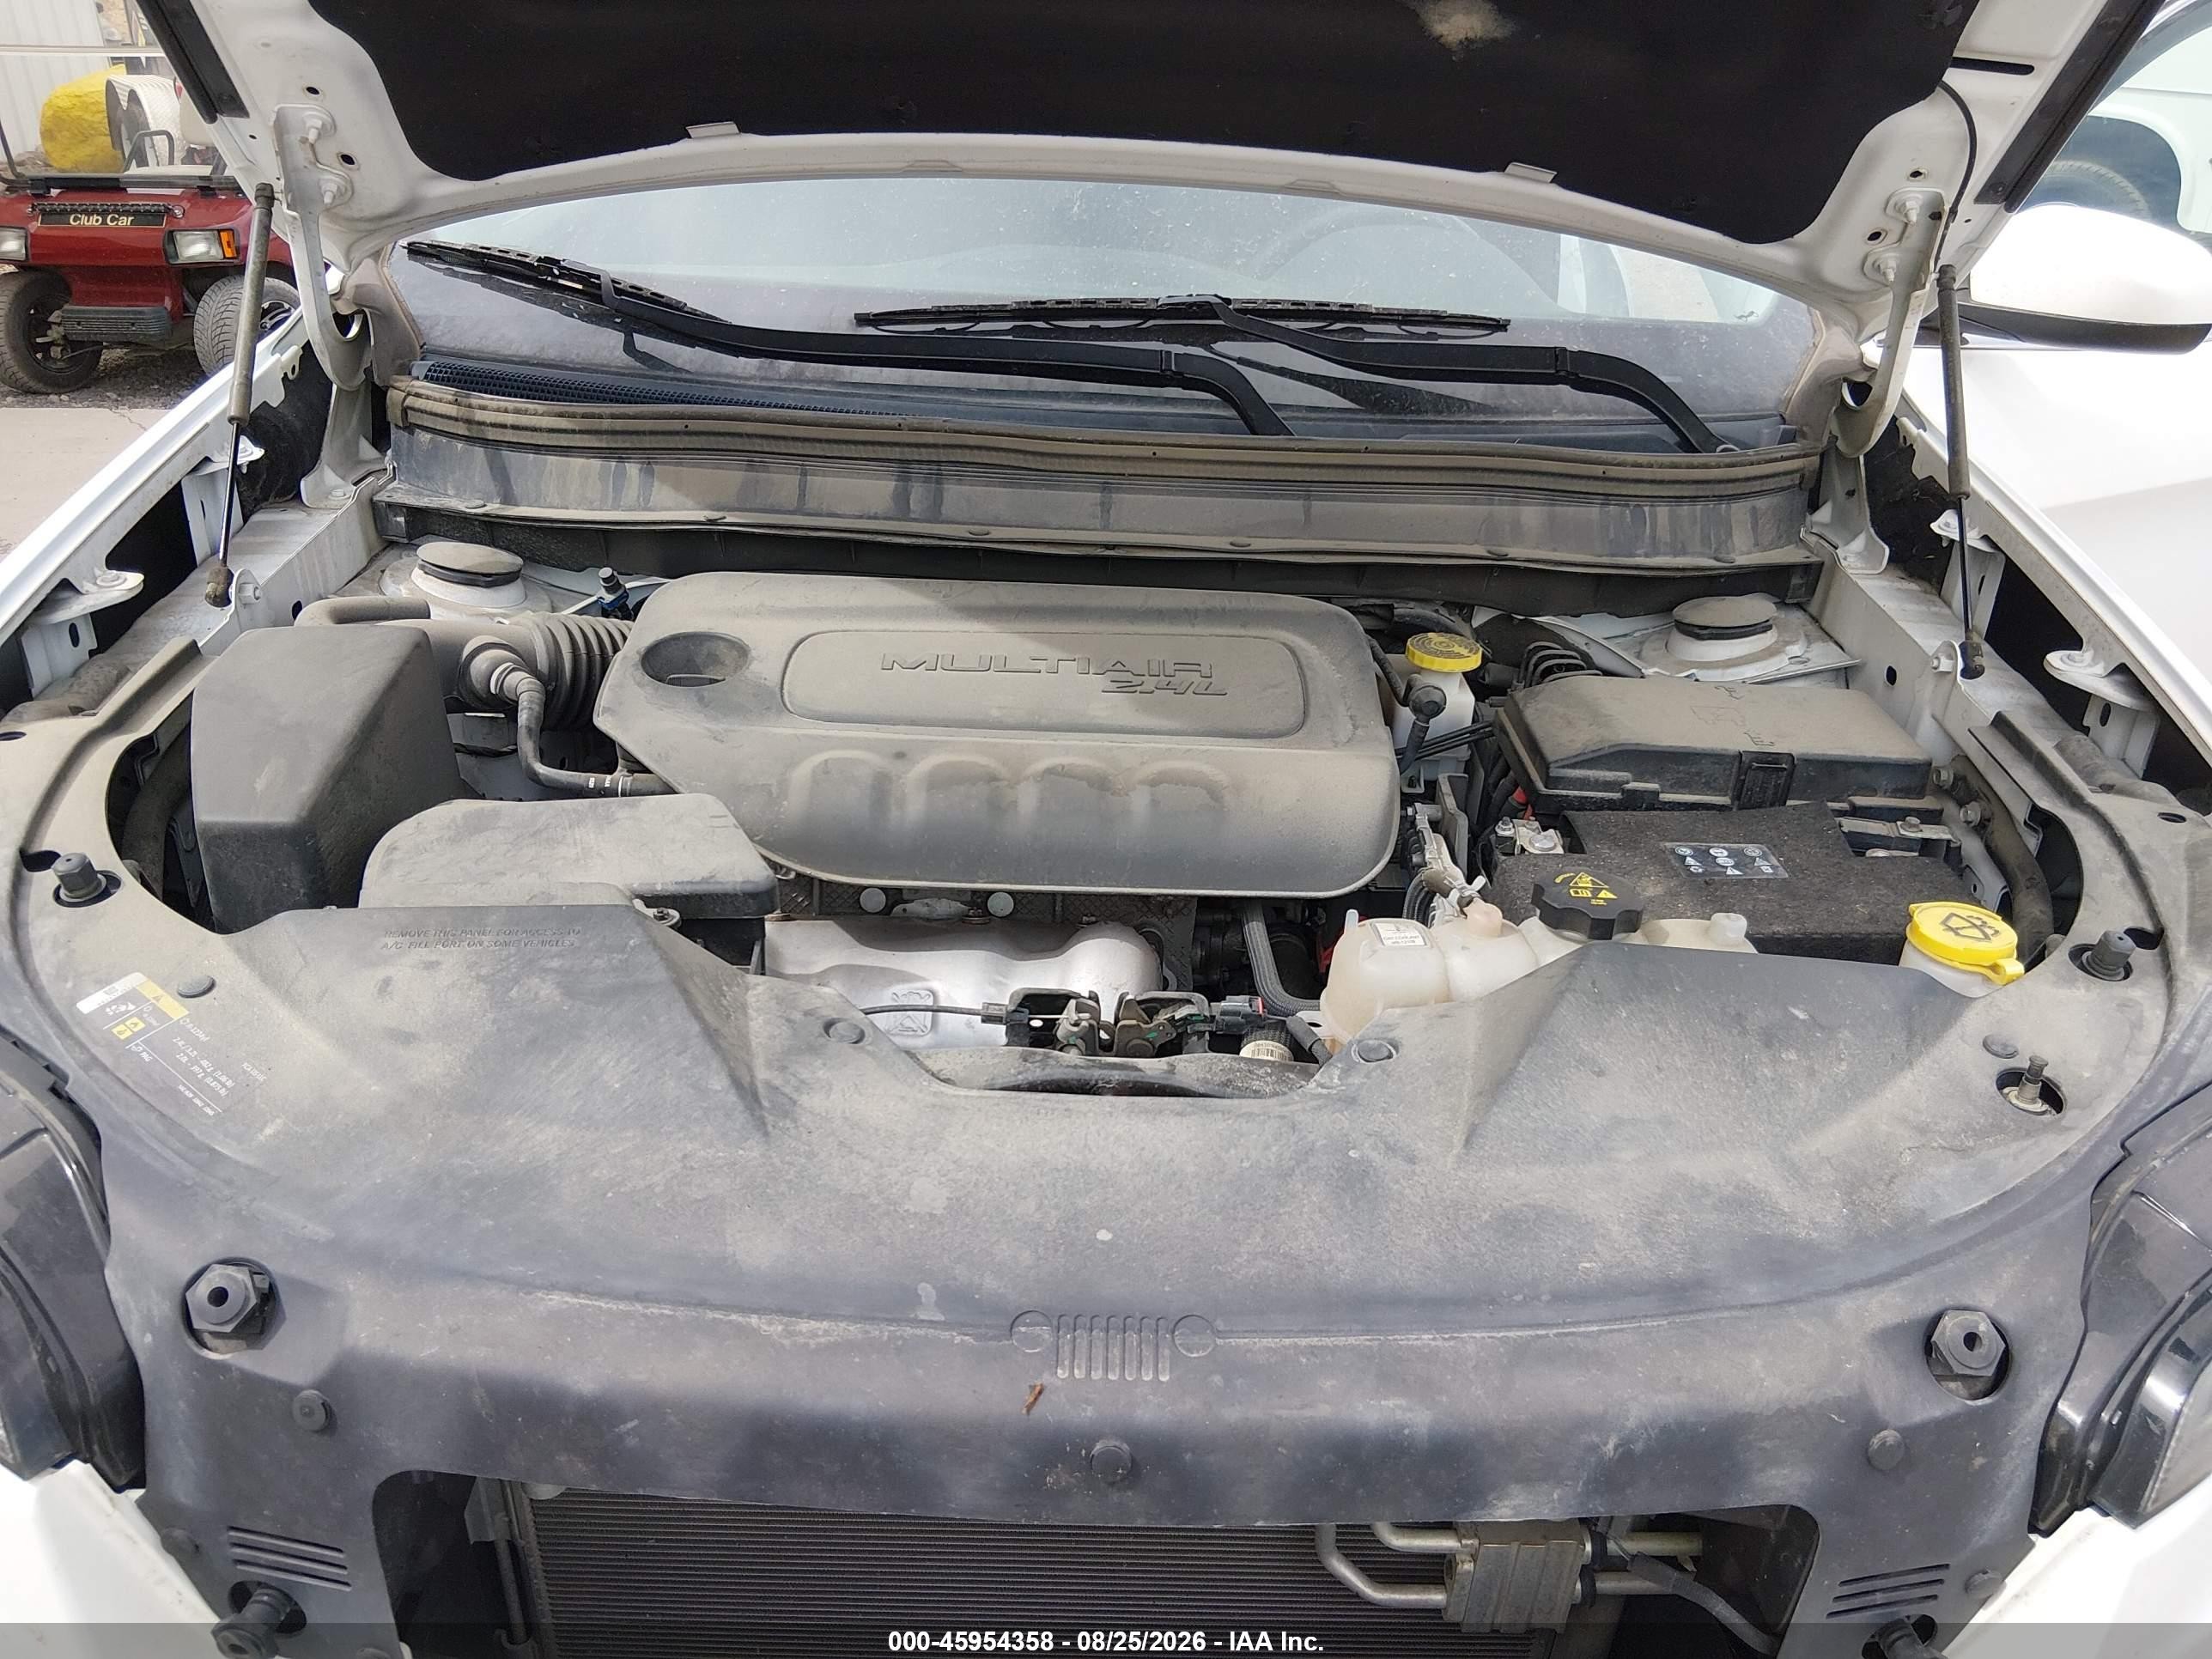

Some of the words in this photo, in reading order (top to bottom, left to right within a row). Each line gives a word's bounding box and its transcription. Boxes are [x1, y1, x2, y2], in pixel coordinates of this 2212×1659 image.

[70, 213, 102, 226] Club
[106, 213, 135, 226] Car
[881, 653, 1213, 678] MULTIAIR
[1102, 679, 1228, 696] 2.4L
[384, 928, 430, 939] REMOVE
[433, 928, 457, 938] THIS
[459, 928, 492, 938] PANEL
[496, 927, 519, 937] FOR
[520, 927, 564, 937] ACCESS
[407, 940, 430, 949] FILL
[434, 939, 462, 949] PORT
[466, 939, 484, 949] ON
[487, 939, 520, 948] SOME
[523, 939, 576, 948] VEHICLES
[139, 1052, 153, 1061] PAG
